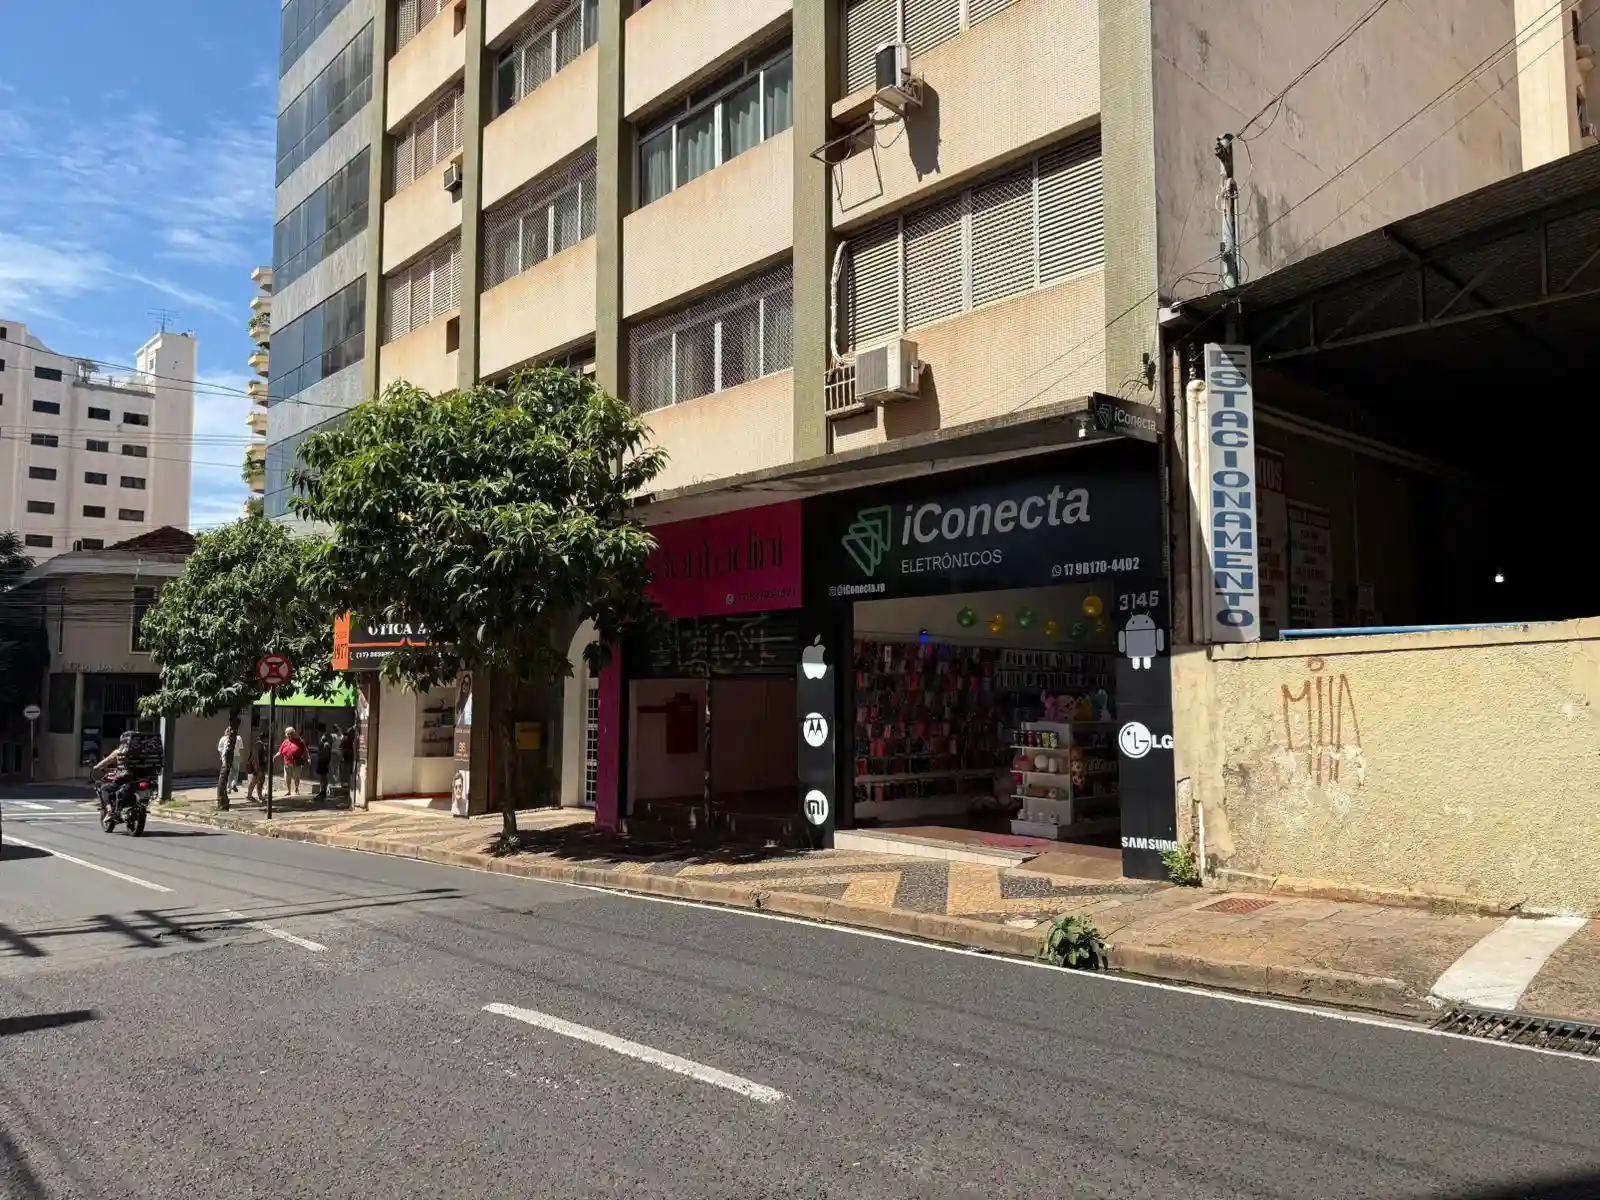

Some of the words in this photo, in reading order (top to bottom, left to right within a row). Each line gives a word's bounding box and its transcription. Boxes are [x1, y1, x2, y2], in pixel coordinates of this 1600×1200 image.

[1114, 407, 1156, 431] iConecta
[1209, 350, 1254, 627] ESTACIONAMENTO
[901, 485, 1091, 545] iConecta
[901, 549, 1002, 573] ELETRÔNICOS
[1064, 564, 1074, 576] 17
[1119, 590, 1159, 611] 3146
[1151, 734, 1174, 749] LG
